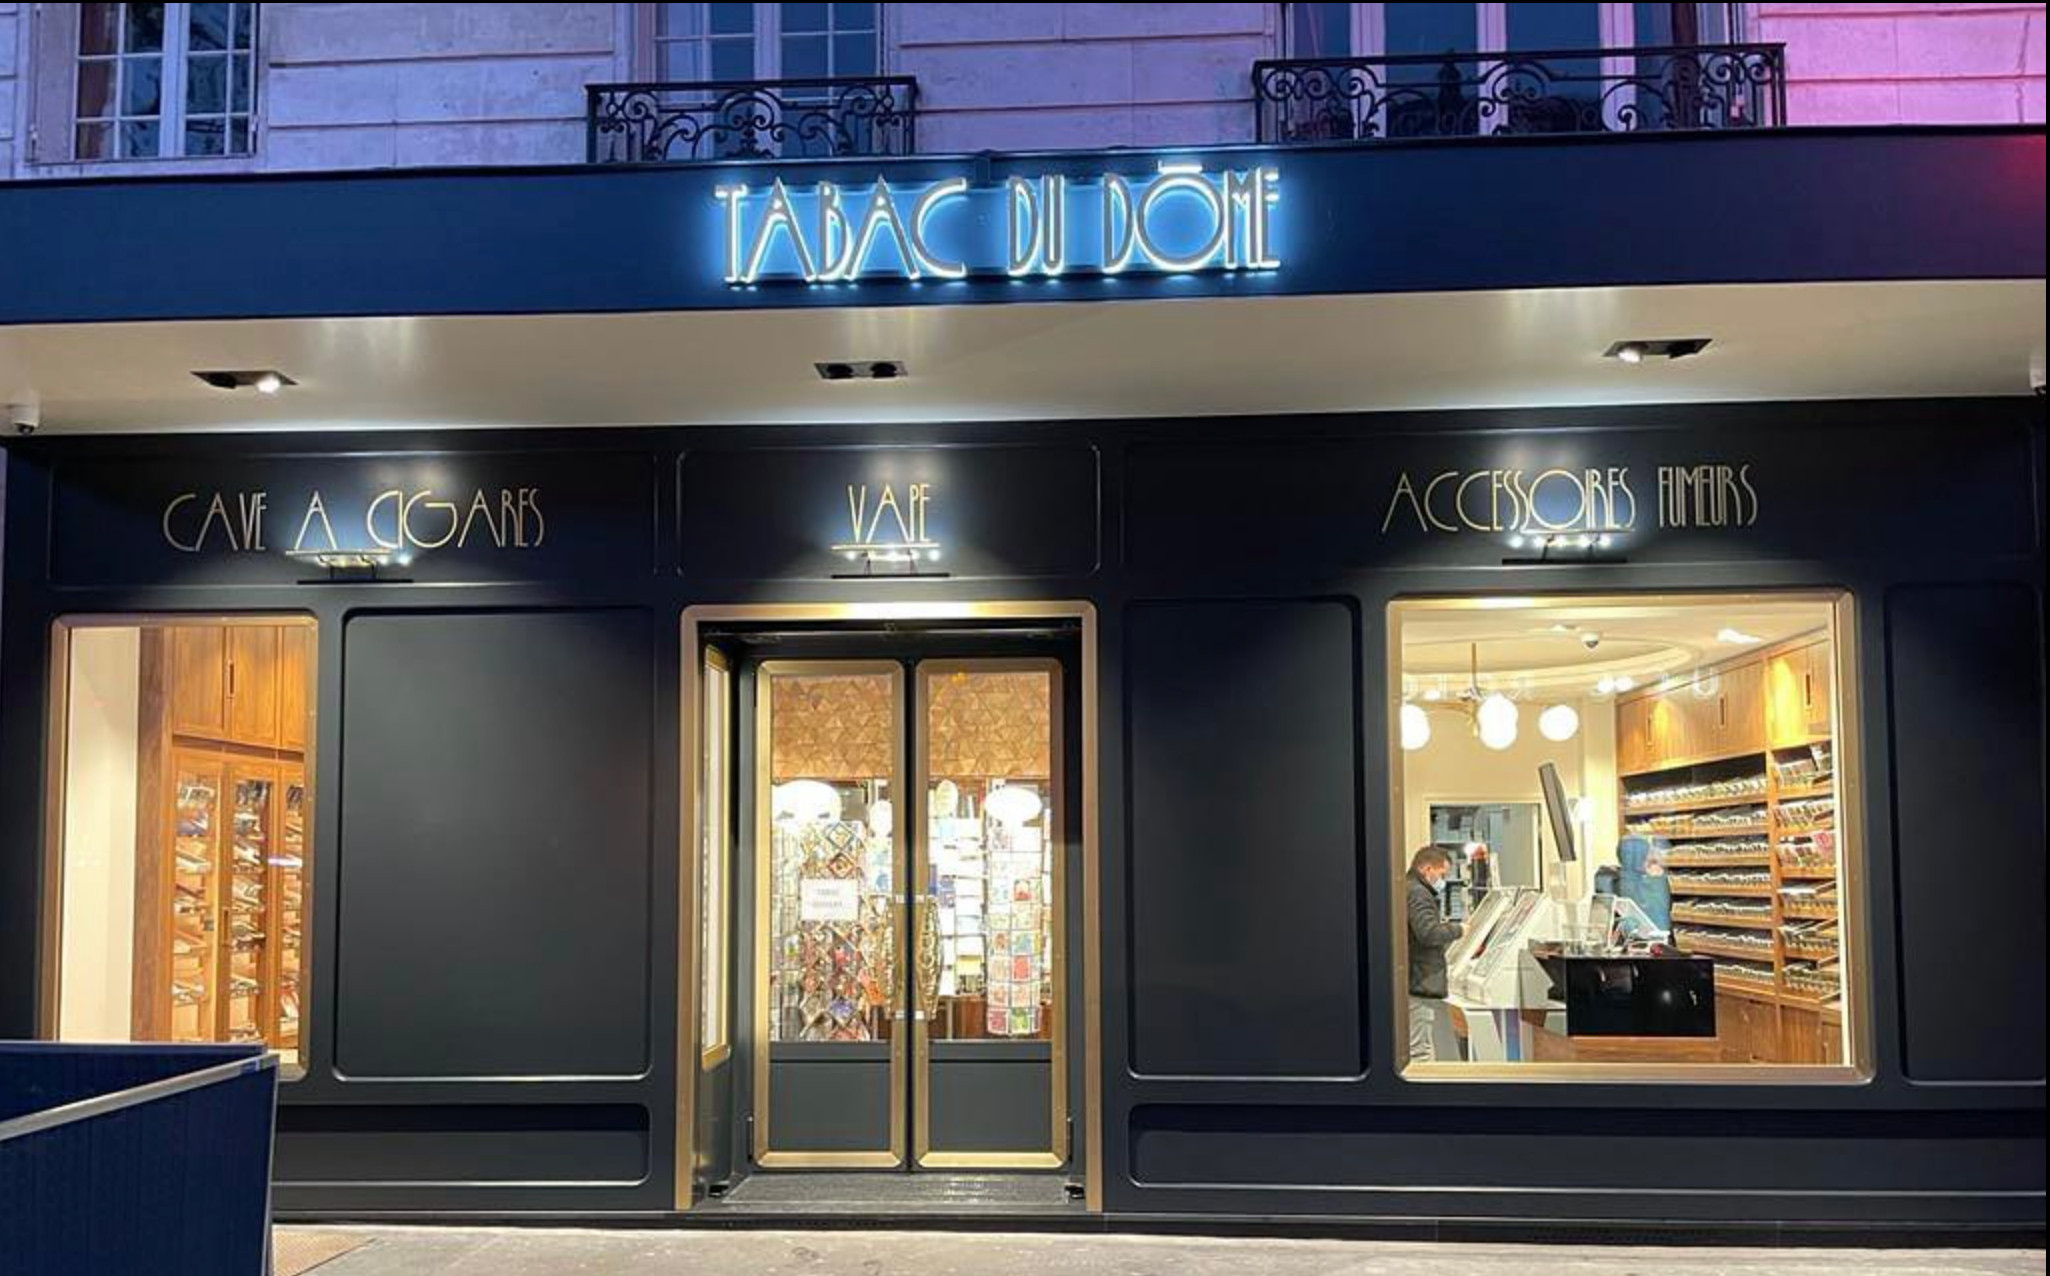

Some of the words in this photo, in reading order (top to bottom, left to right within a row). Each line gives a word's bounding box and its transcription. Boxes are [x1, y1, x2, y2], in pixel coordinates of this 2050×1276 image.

[715, 174, 967, 282] TABAC
[1007, 174, 1065, 277] DU
[163, 492, 267, 551] CAVE
[295, 490, 337, 549] A
[367, 488, 544, 548] CIGARES
[848, 484, 931, 543] VAPE
[1382, 467, 1636, 532] ACCESSOIRES
[1658, 464, 1758, 528] FUMEURS
